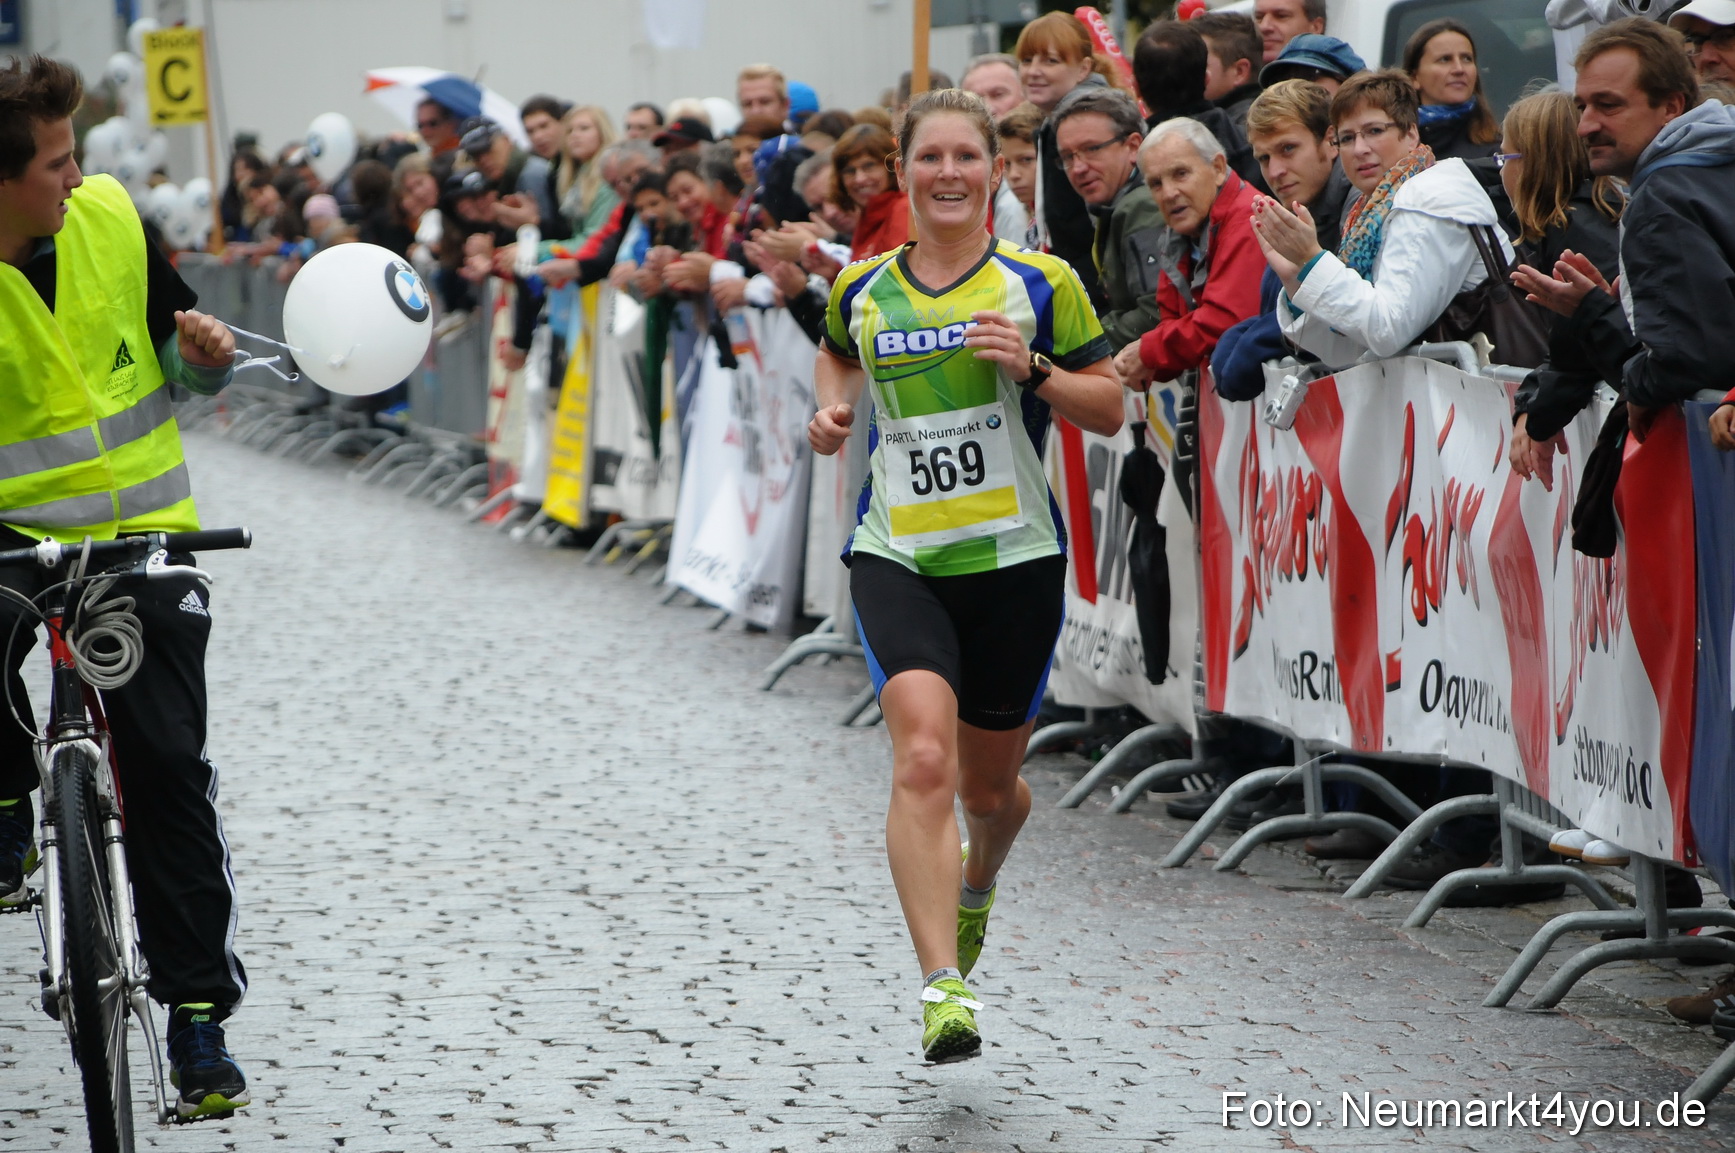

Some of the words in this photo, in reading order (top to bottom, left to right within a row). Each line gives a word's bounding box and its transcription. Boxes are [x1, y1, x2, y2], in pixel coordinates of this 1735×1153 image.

[160, 57, 191, 102] C
[885, 432, 916, 445] PARTL
[918, 421, 981, 440] Neumarkt
[908, 440, 985, 496] 569
[178, 603, 208, 617] adida
